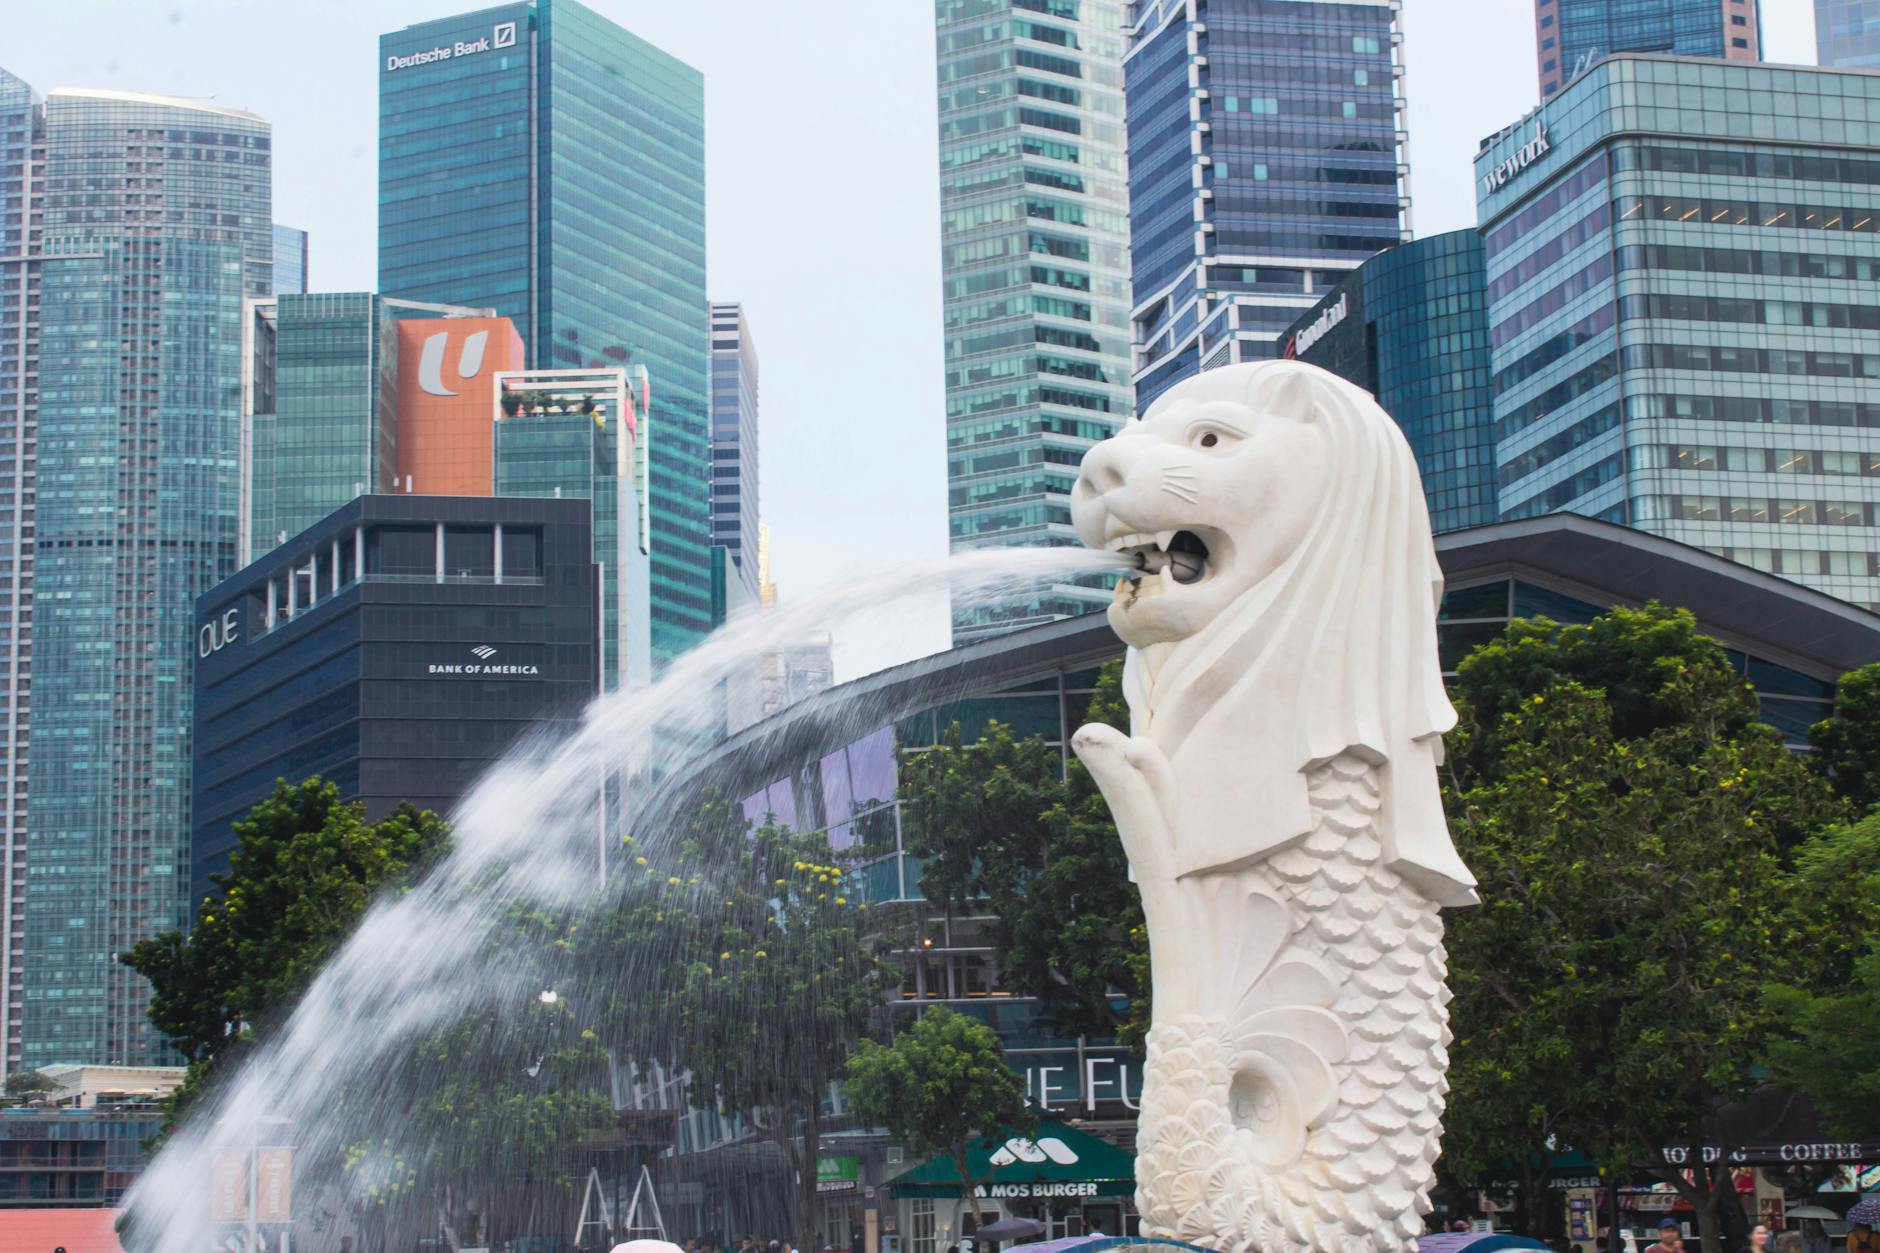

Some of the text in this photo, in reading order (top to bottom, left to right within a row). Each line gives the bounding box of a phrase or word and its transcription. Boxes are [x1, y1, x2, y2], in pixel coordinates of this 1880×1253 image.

[387, 37, 490, 71] Deutsche Bank
[1484, 120, 1550, 194] wework
[200, 608, 239, 658] OUE
[429, 664, 539, 675] BANK OF AMERICA
[1780, 1143, 1862, 1161] COFFEE
[991, 1182, 1098, 1198] MOS BURGER
